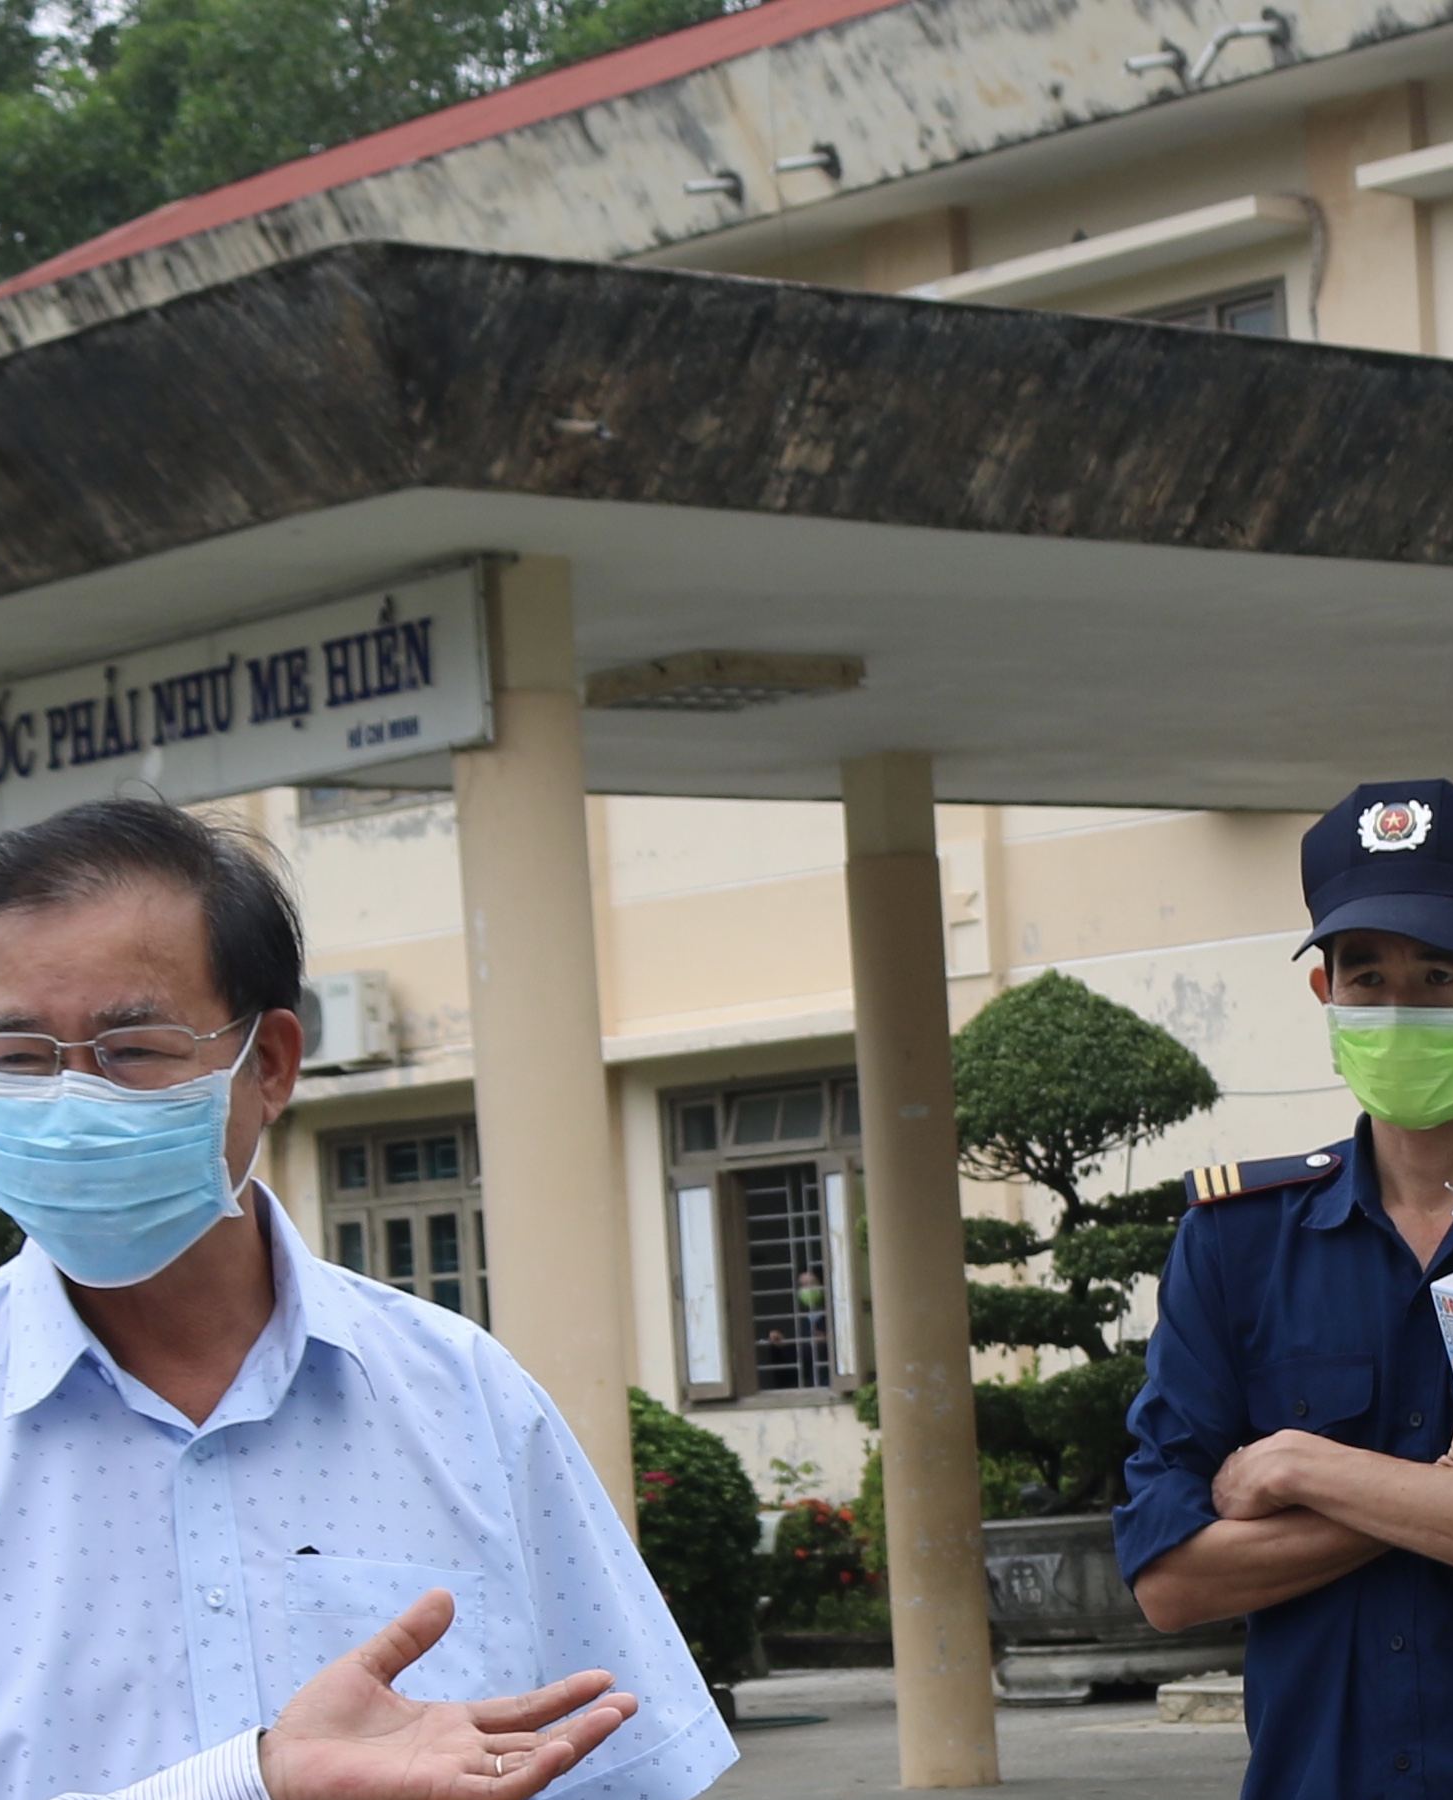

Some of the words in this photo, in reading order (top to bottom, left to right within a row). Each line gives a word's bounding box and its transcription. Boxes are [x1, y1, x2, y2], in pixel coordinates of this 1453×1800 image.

[46, 665, 140, 770] PHẢI
[149, 653, 237, 746] NHƯ
[246, 647, 311, 729] MẸ
